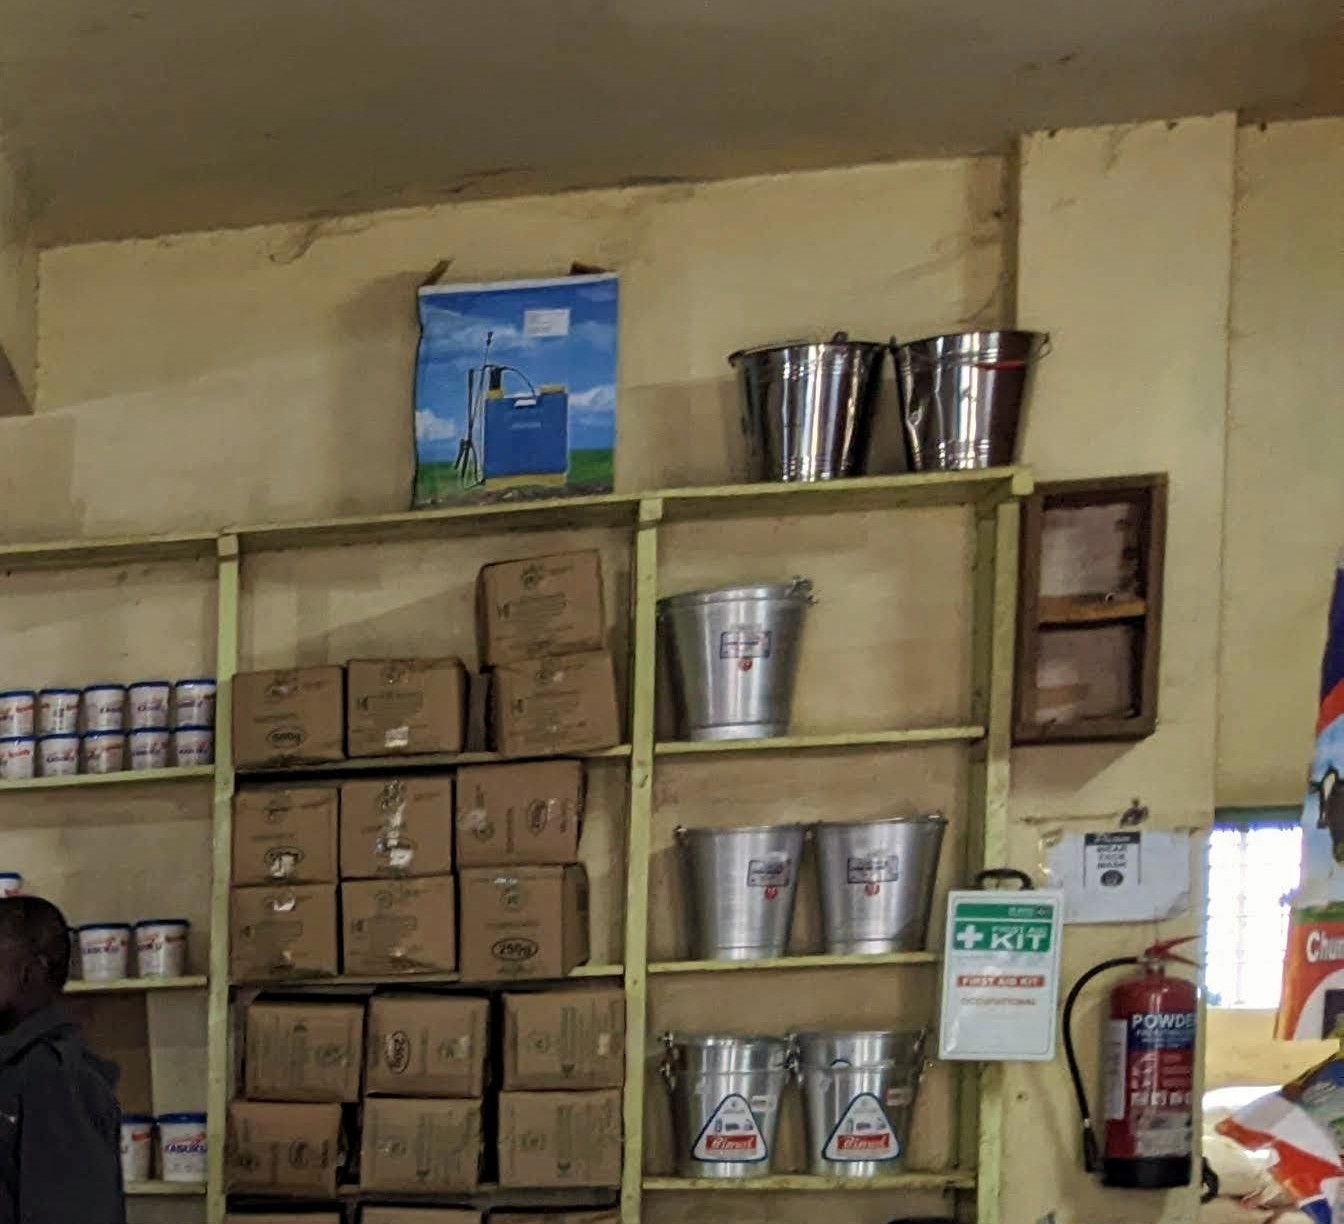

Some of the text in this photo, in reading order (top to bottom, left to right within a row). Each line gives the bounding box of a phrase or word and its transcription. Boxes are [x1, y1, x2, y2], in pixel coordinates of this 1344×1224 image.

[991, 932, 1047, 951] KIT
[962, 976, 1041, 987] FIRST AID KIT
[1132, 1013, 1196, 1029] POWDE
